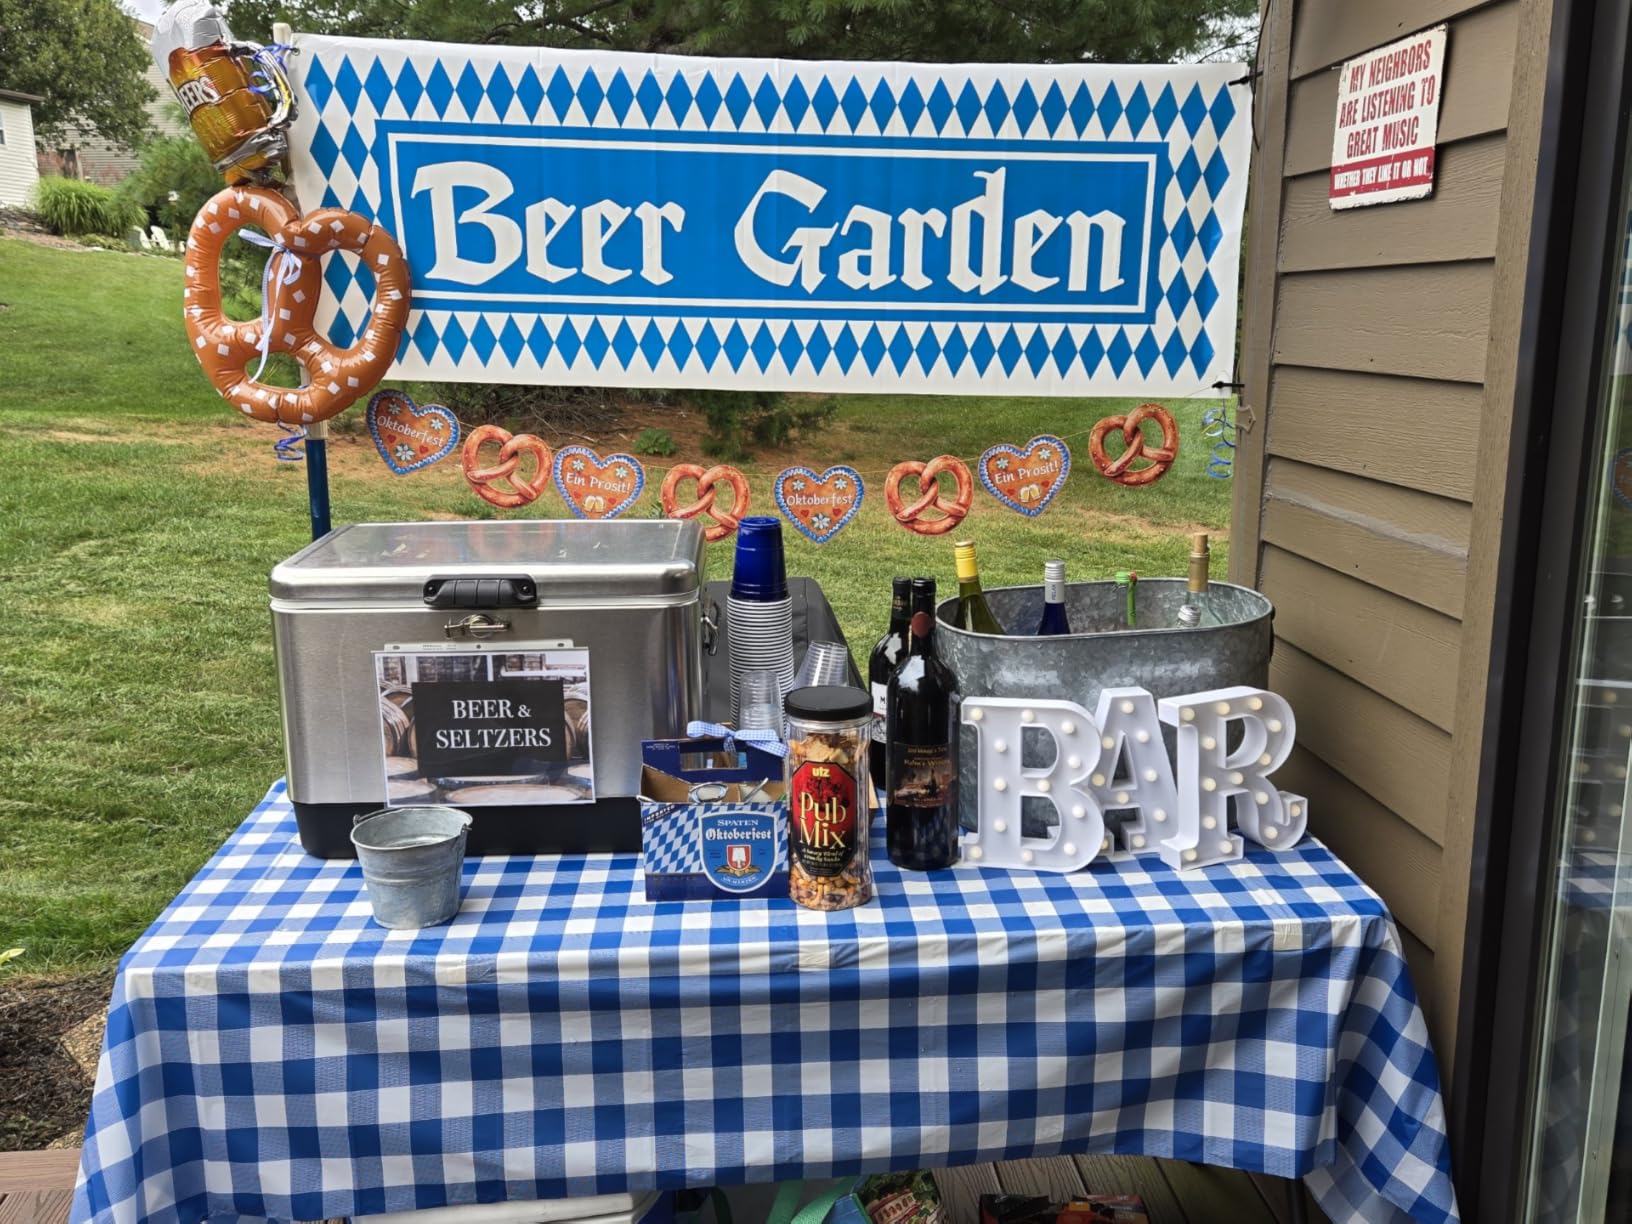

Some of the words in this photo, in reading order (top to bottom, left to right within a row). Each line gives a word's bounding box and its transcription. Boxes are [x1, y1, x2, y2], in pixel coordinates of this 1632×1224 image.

[1349, 62, 1367, 94] MY
[1368, 39, 1432, 87] NEIGHBORS
[1338, 99, 1358, 129] ARE
[1361, 81, 1416, 122] LISTENING
[1420, 74, 1436, 107] TO
[1346, 126, 1380, 159] GREAT
[1382, 115, 1420, 151] MUSIC
[1362, 166, 1378, 185] THEY
[1378, 163, 1393, 183] LIKE
[1392, 161, 1402, 180] IT
[1401, 159, 1412, 179] OR
[411, 160, 686, 286] Beer
[733, 165, 1127, 296] Garden
[377, 415, 445, 448] Oktoberfest
[565, 471, 586, 486] Ein
[590, 476, 631, 493] Prosit!
[994, 469, 1015, 485] Ein
[1019, 461, 1060, 480] Prosit!
[786, 493, 853, 507] Oktoberfest
[452, 699, 515, 720] BEER
[517, 704, 532, 718] &
[436, 727, 552, 750] SELTZERS
[961, 685, 1309, 874] BAR
[800, 791, 847, 825] Pub
[705, 828, 772, 841] Oktoberfest
[717, 819, 759, 827] SPATEN
[799, 818, 847, 850] Mix
